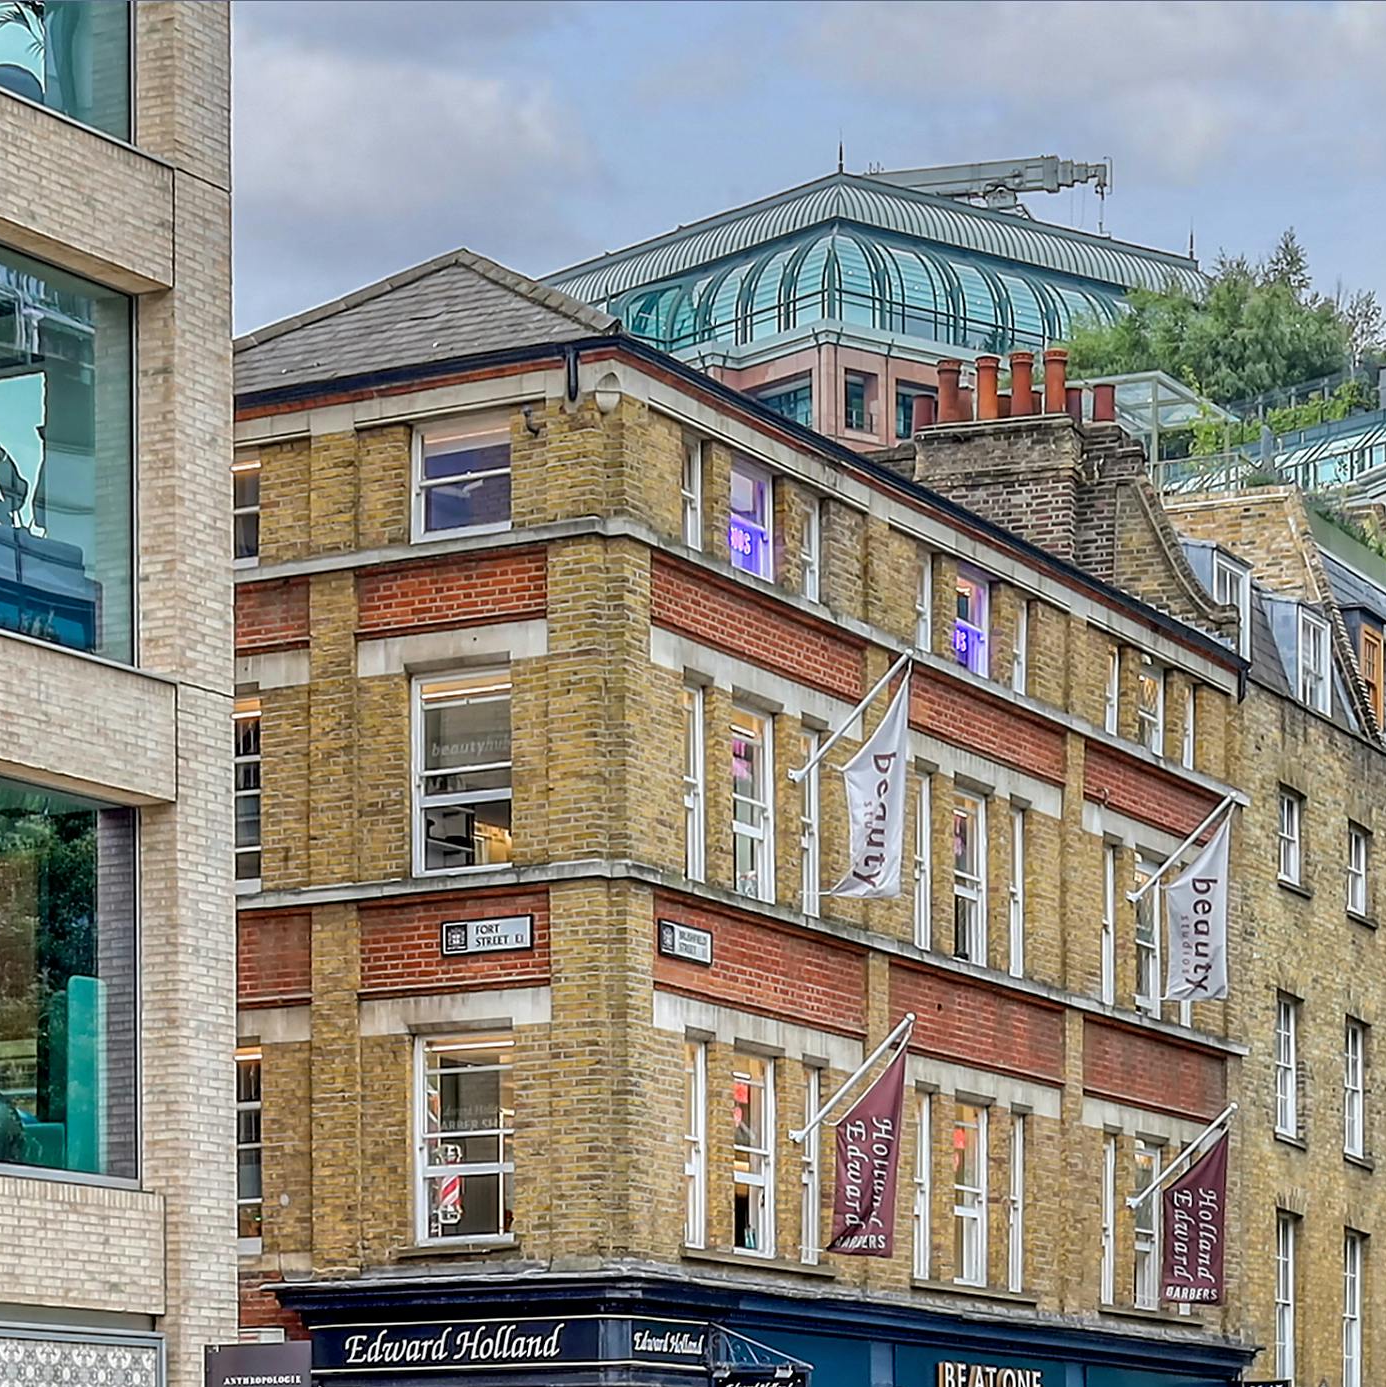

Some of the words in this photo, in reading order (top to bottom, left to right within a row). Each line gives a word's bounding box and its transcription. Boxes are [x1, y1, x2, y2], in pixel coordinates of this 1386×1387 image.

[852, 751, 897, 888] beauty
[475, 924, 500, 935] FORT
[475, 934, 509, 947] STREET
[1180, 915, 1192, 974] studios
[1185, 877, 1218, 992] beauty
[442, 1119, 479, 1131] ARBER
[845, 1120, 869, 1230] Edward
[1174, 1190, 1195, 1282] Edward
[1198, 1188, 1219, 1283] Holland
[1166, 1286, 1218, 1300] BARBERS
[345, 1327, 452, 1364] Edward
[454, 1323, 565, 1361] Holland
[634, 1330, 670, 1352] Edward
[669, 1332, 705, 1355] Holland
[223, 1375, 302, 1386] ANTHROPOLOGIE
